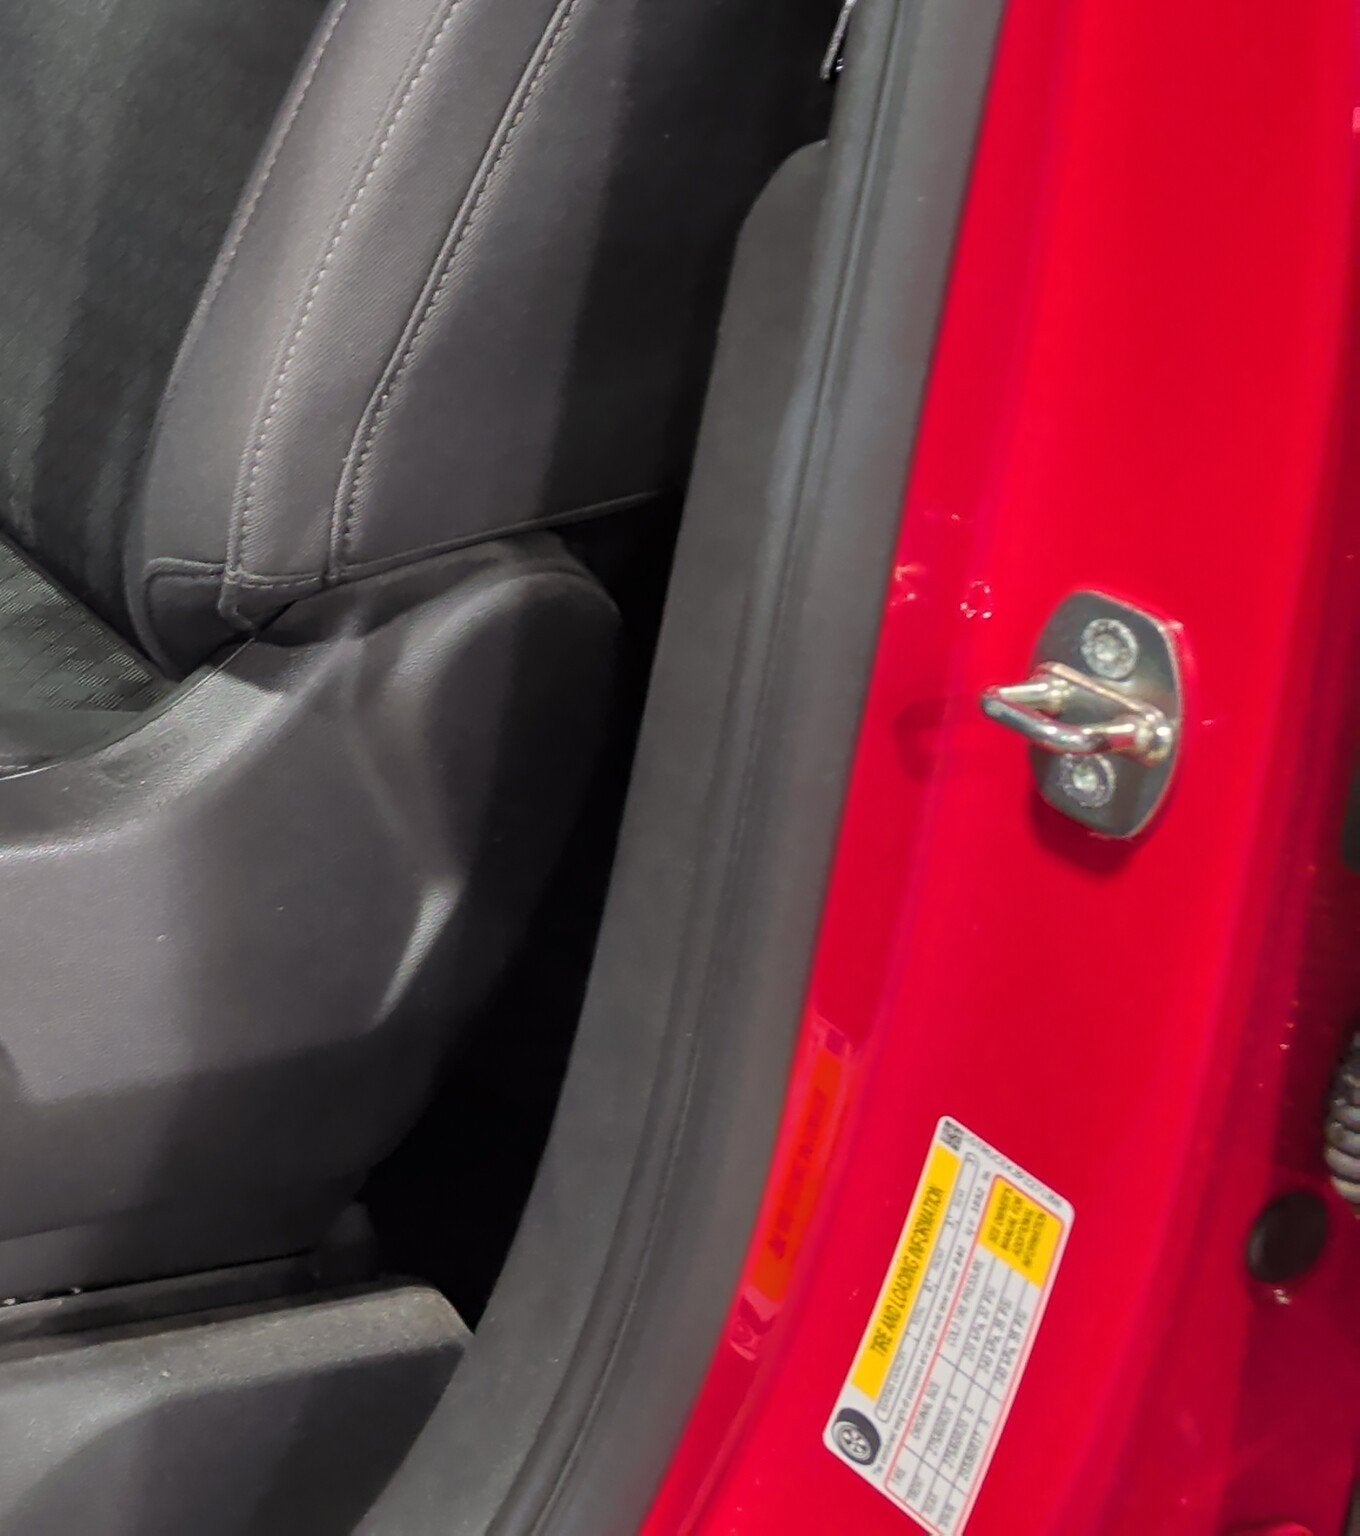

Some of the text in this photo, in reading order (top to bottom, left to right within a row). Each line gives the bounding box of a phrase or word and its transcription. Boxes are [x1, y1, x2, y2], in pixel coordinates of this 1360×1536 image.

[869, 1180, 946, 1359] TIRE AND LOADING INFORMATION
